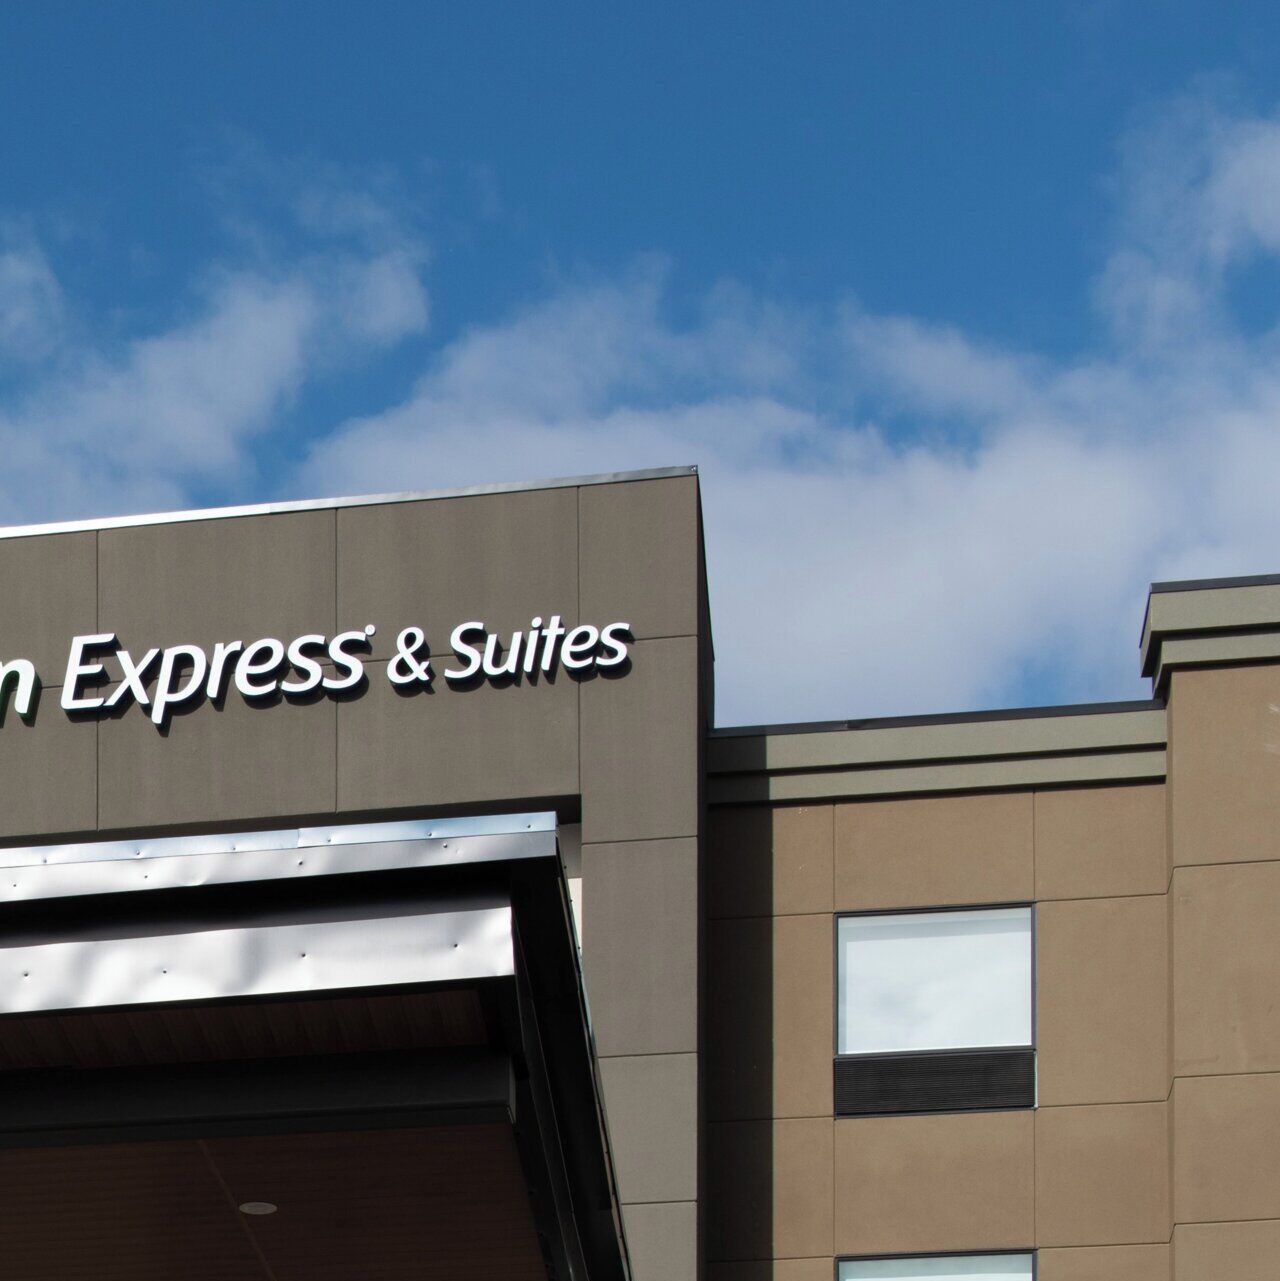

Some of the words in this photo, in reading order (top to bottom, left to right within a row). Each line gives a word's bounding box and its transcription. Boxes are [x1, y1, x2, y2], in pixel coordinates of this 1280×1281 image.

[61, 627, 372, 724] Express
[387, 627, 430, 684] &
[445, 616, 630, 679] Suites
